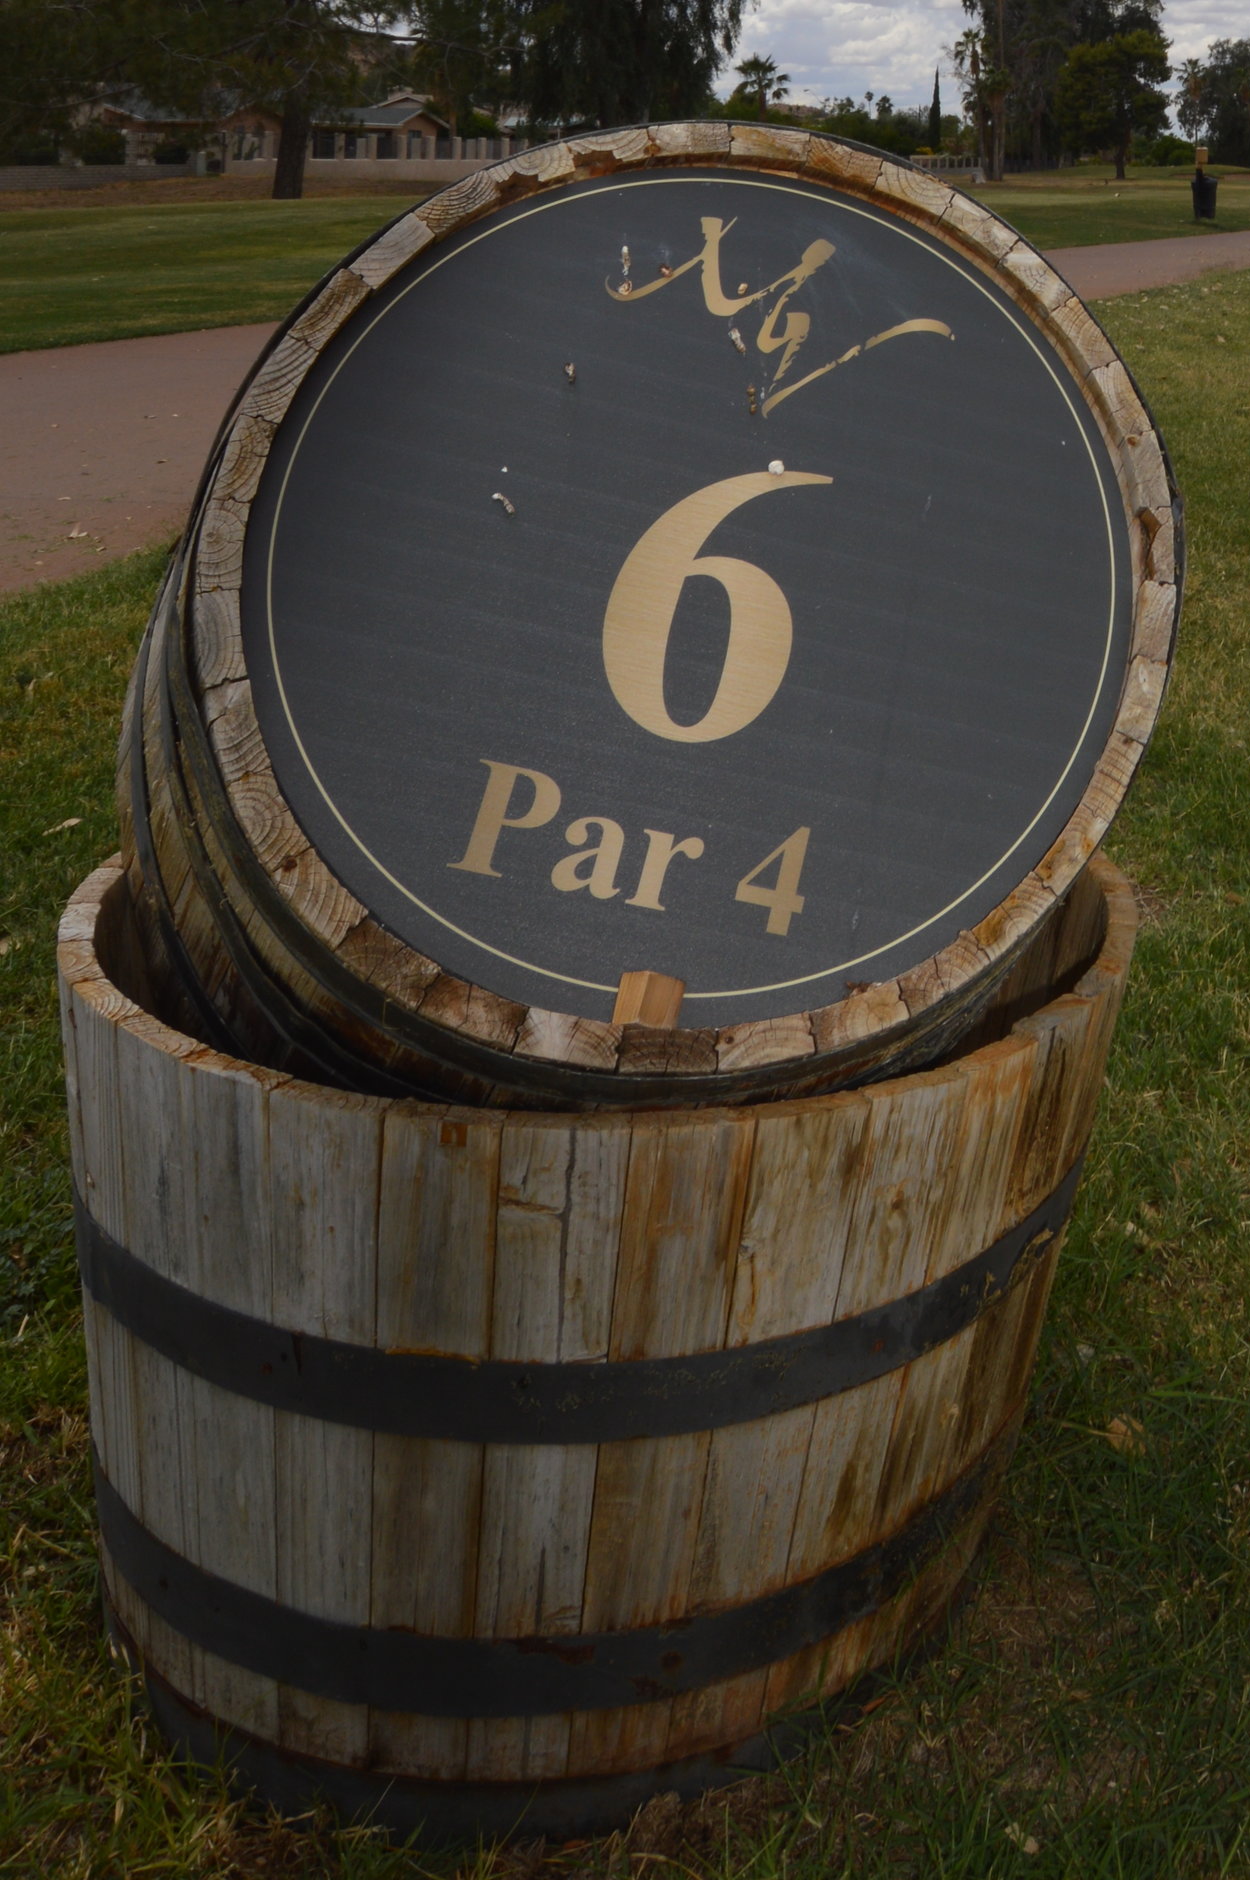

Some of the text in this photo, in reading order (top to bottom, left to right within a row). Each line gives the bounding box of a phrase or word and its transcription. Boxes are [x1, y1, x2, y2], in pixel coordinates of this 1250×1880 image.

[602, 470, 833, 743] 6
[447, 759, 812, 936] Par 4
